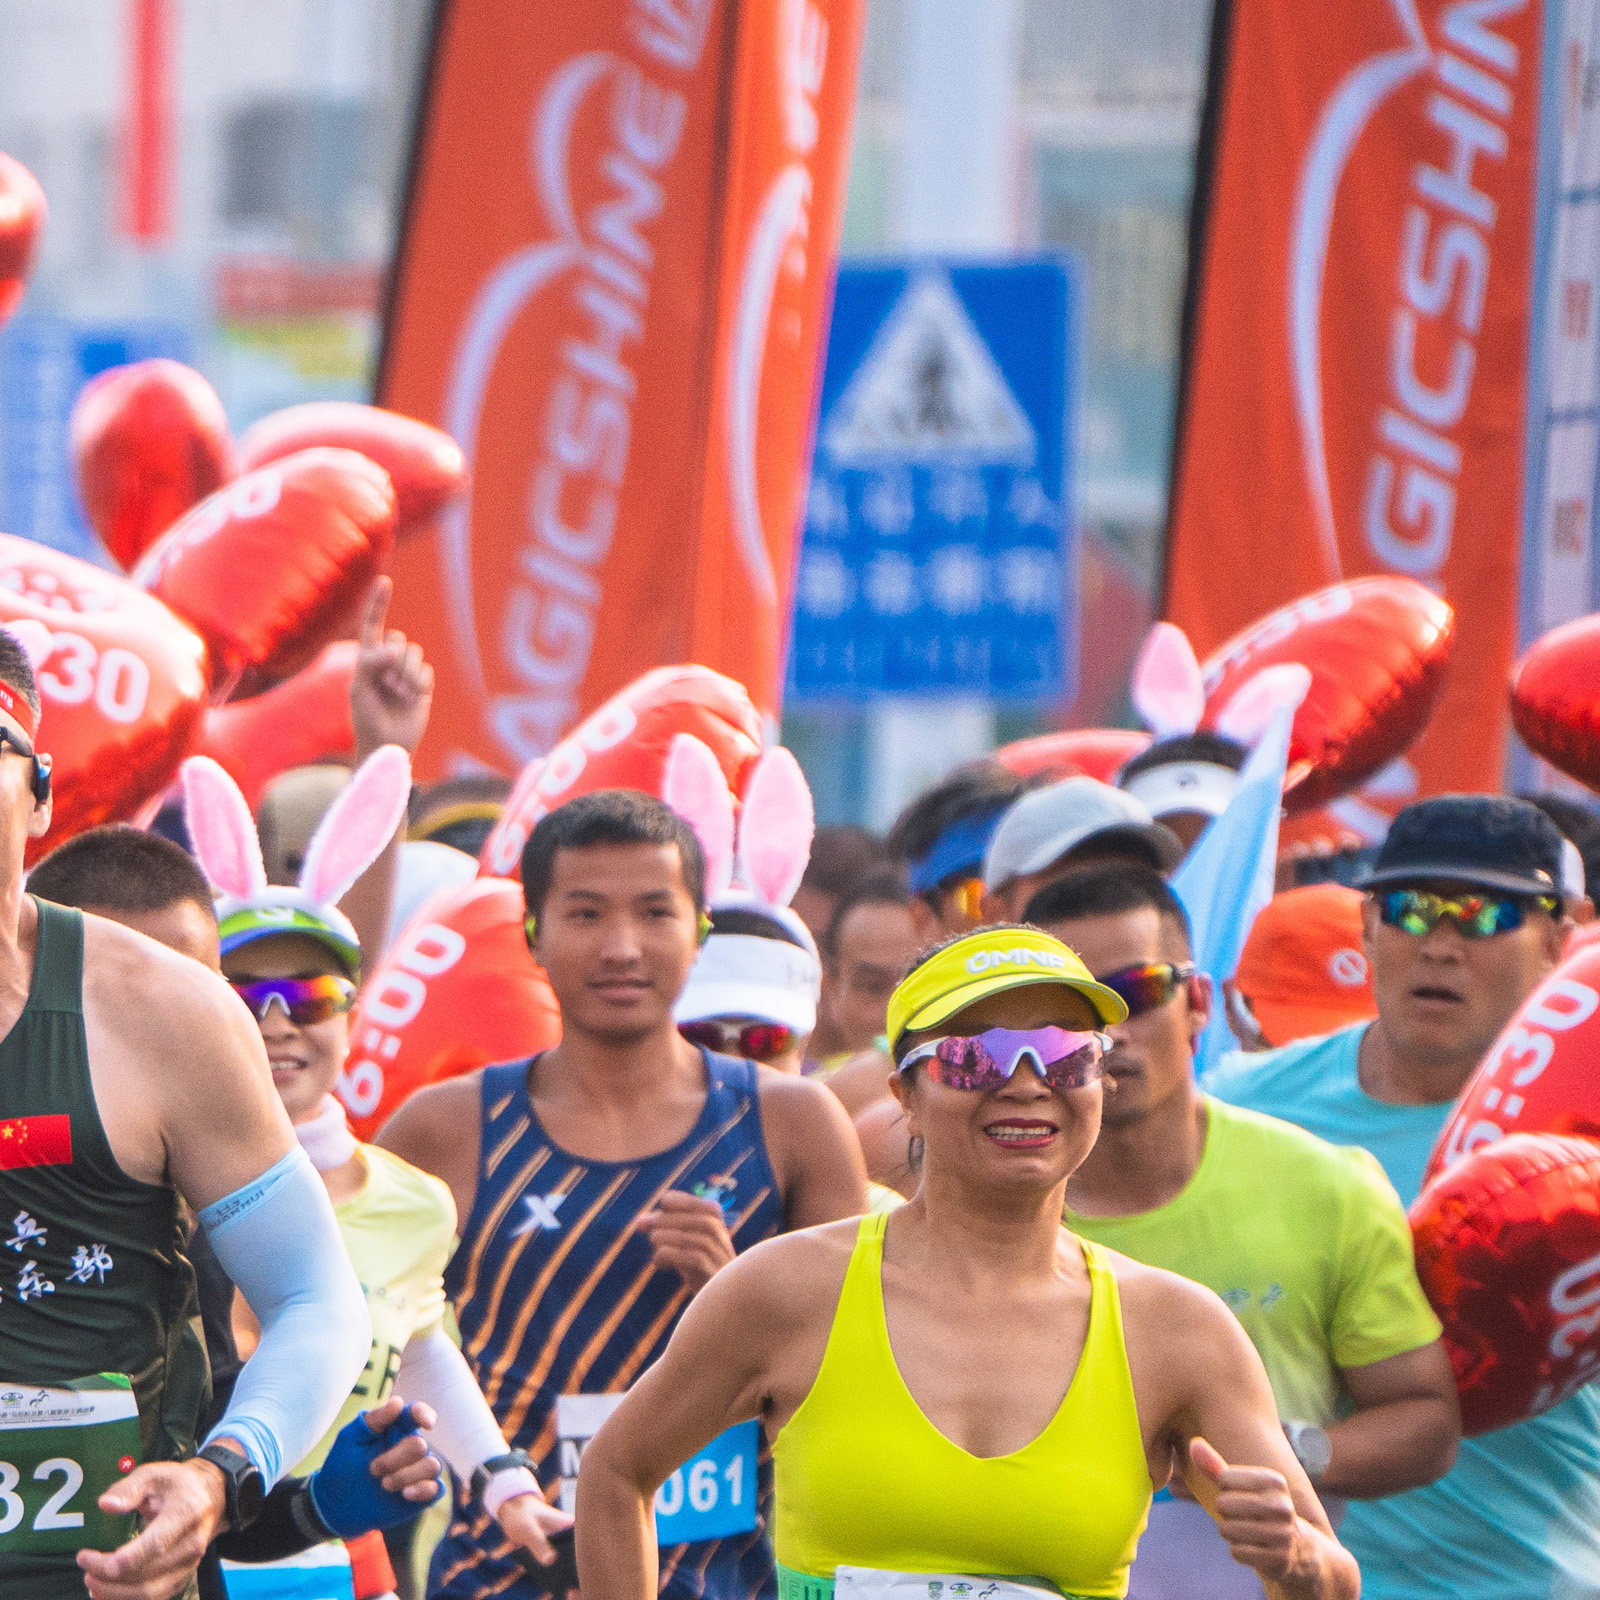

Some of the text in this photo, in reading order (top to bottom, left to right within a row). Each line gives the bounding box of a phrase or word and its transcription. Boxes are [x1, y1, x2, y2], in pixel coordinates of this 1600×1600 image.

[442, 66, 688, 780] AGICSHINE
[334, 922, 469, 1118] 6:00
[1445, 977, 1600, 1168] 5:30
